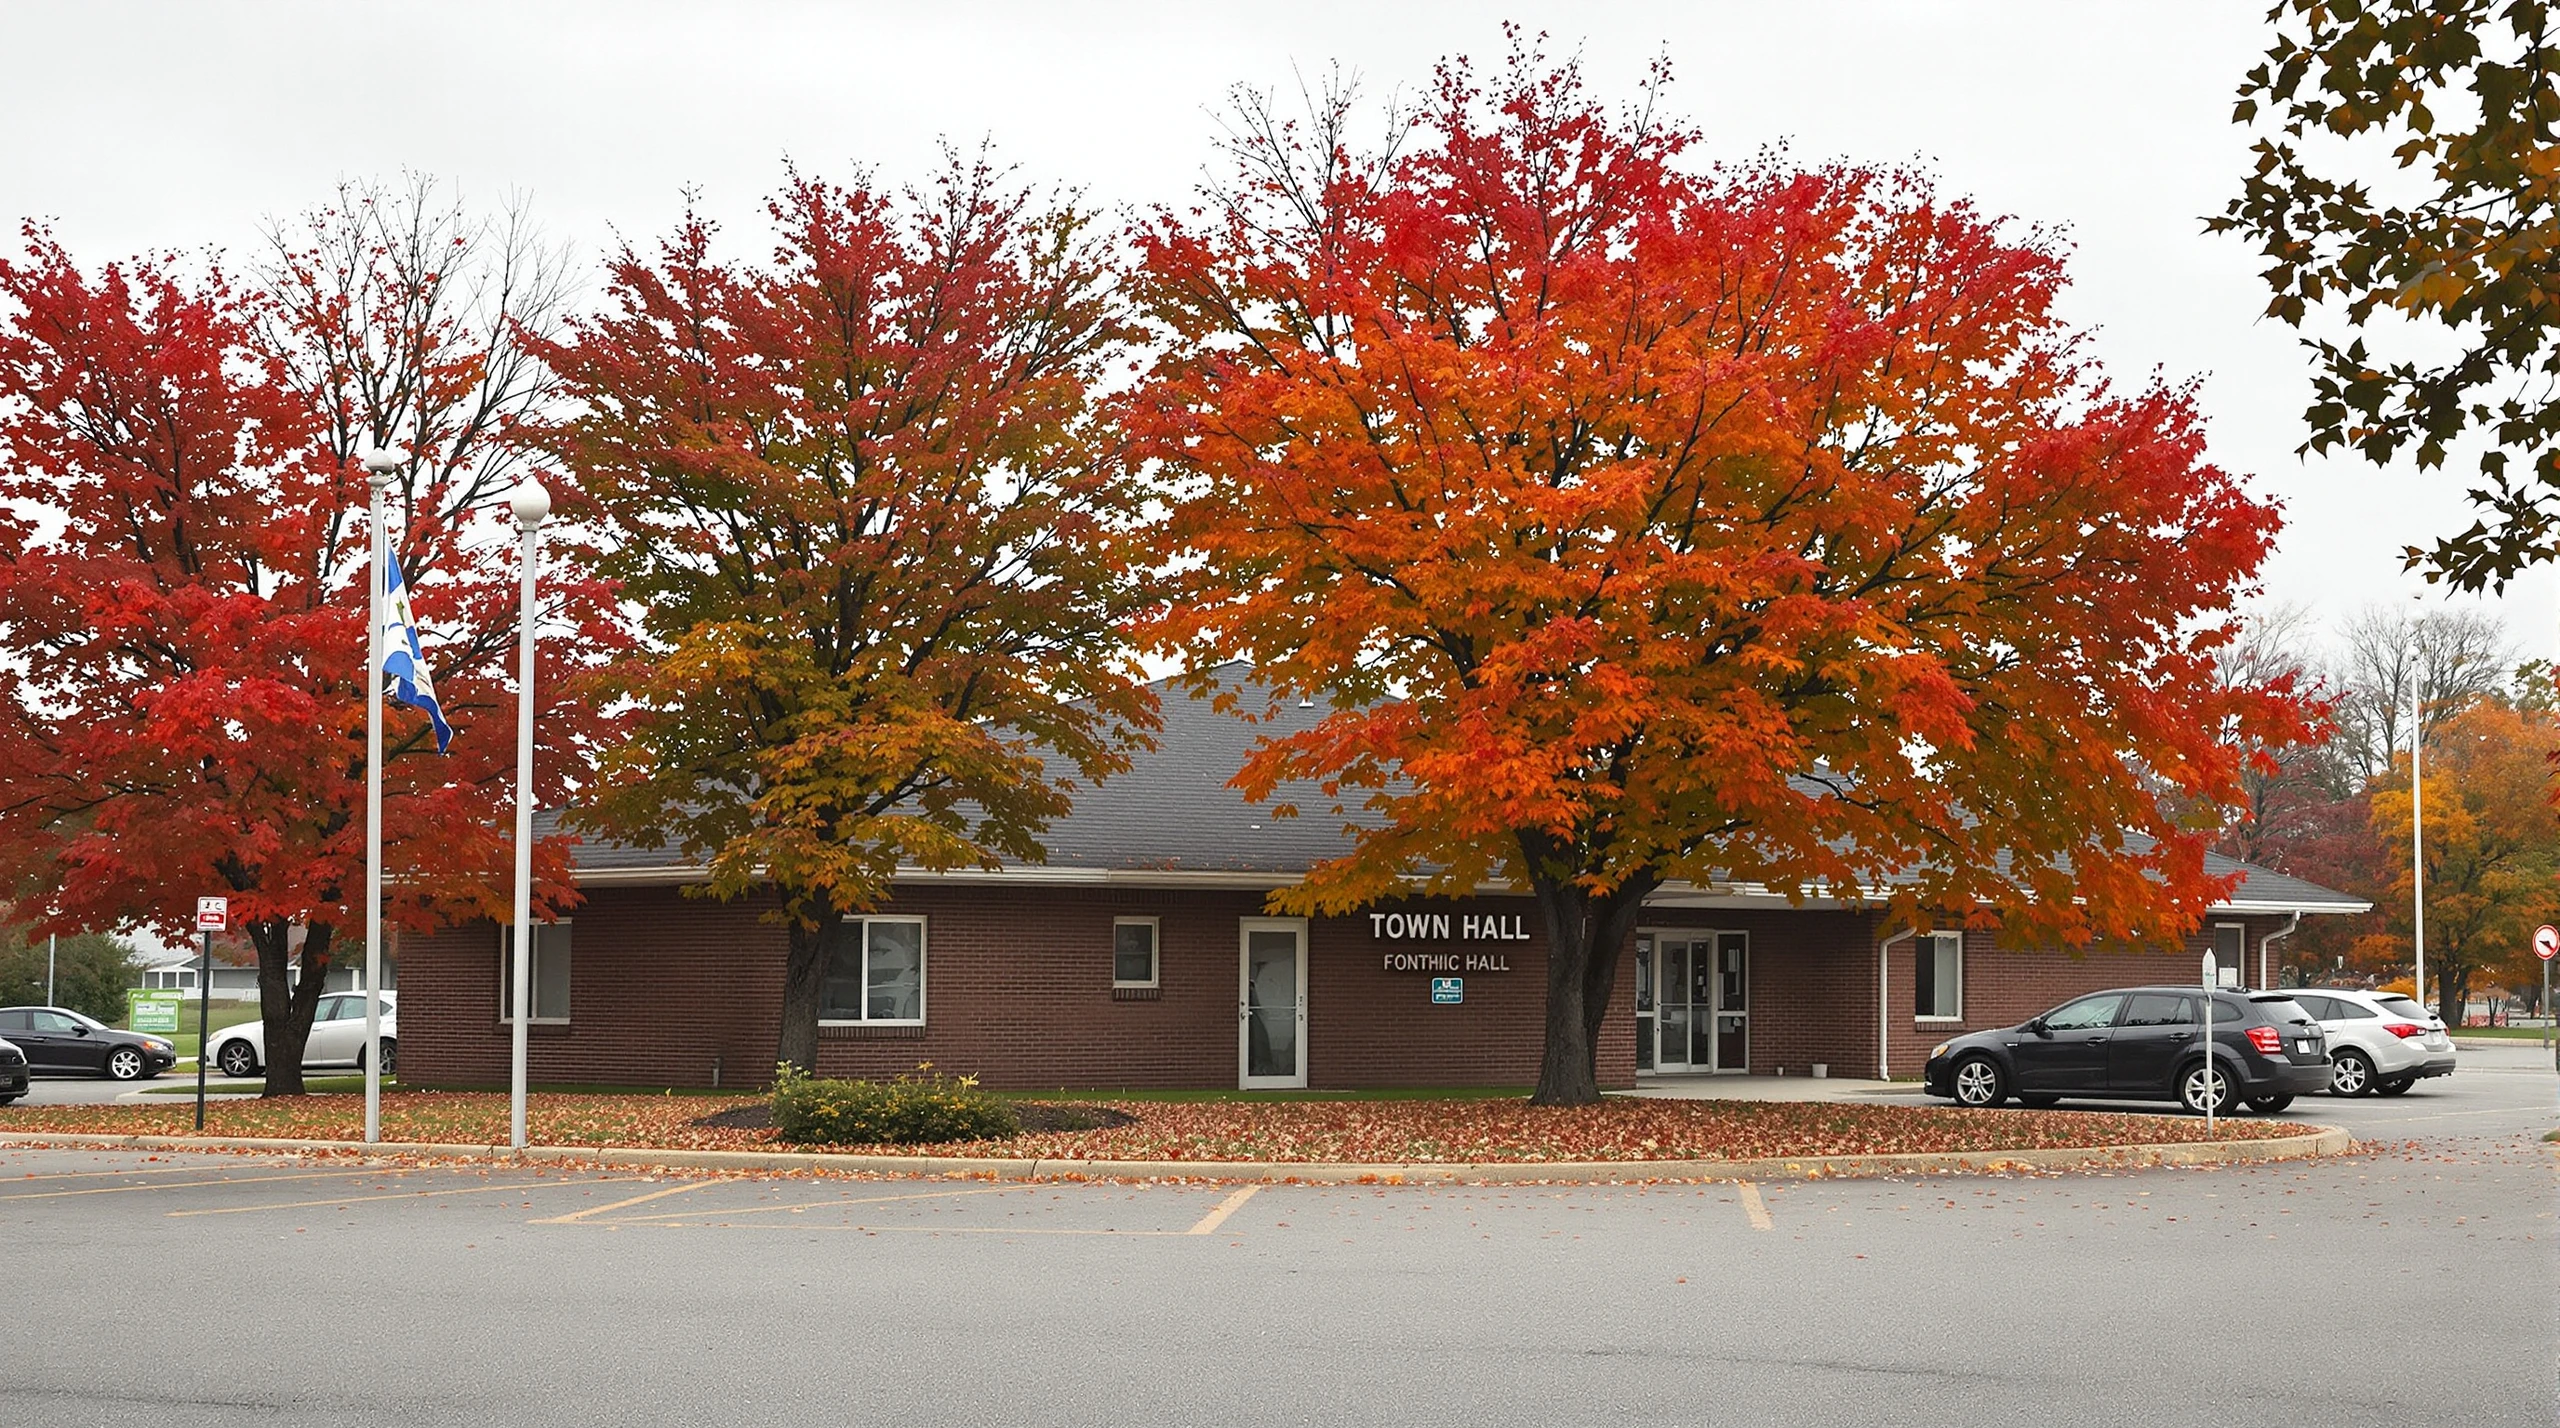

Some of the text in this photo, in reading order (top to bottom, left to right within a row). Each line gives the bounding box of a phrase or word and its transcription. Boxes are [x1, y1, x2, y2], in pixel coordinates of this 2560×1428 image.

[1369, 913, 1530, 940] TOWN HALL
[1466, 955, 1510, 971] HALL
